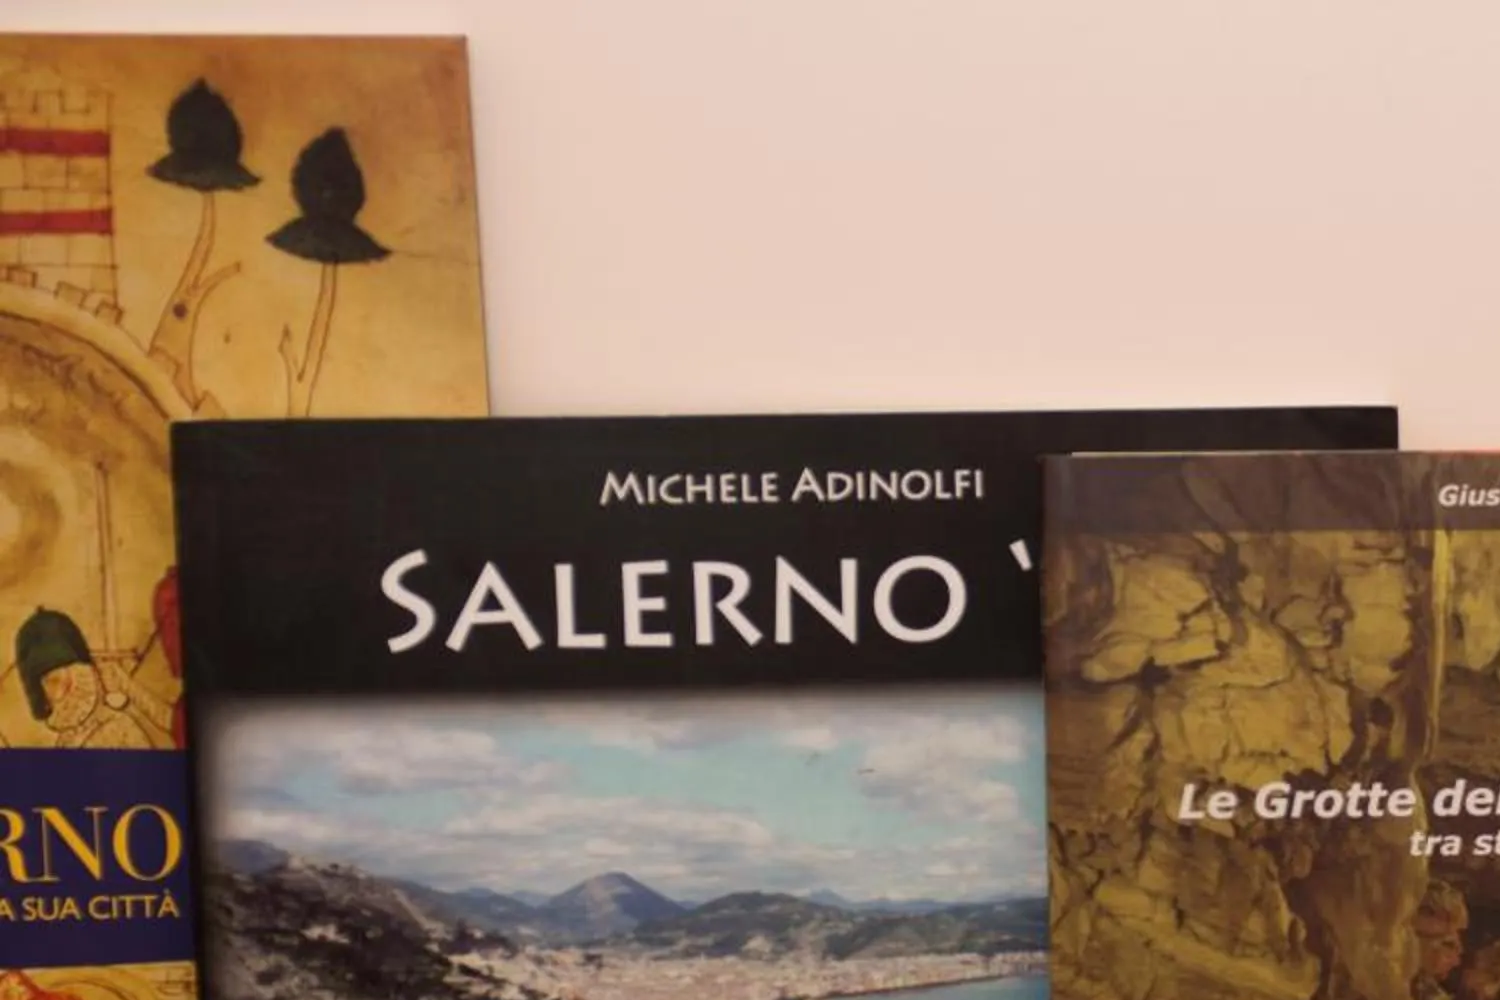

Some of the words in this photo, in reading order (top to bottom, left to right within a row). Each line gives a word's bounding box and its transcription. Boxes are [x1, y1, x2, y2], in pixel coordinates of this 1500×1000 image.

[380, 549, 968, 654] SALERNO
[1178, 783, 1238, 819] Le
[1254, 781, 1417, 820] Grotte
[1409, 829, 1463, 857] tra
[22, 896, 82, 921] SUA
[88, 887, 181, 920] CITTÀ
